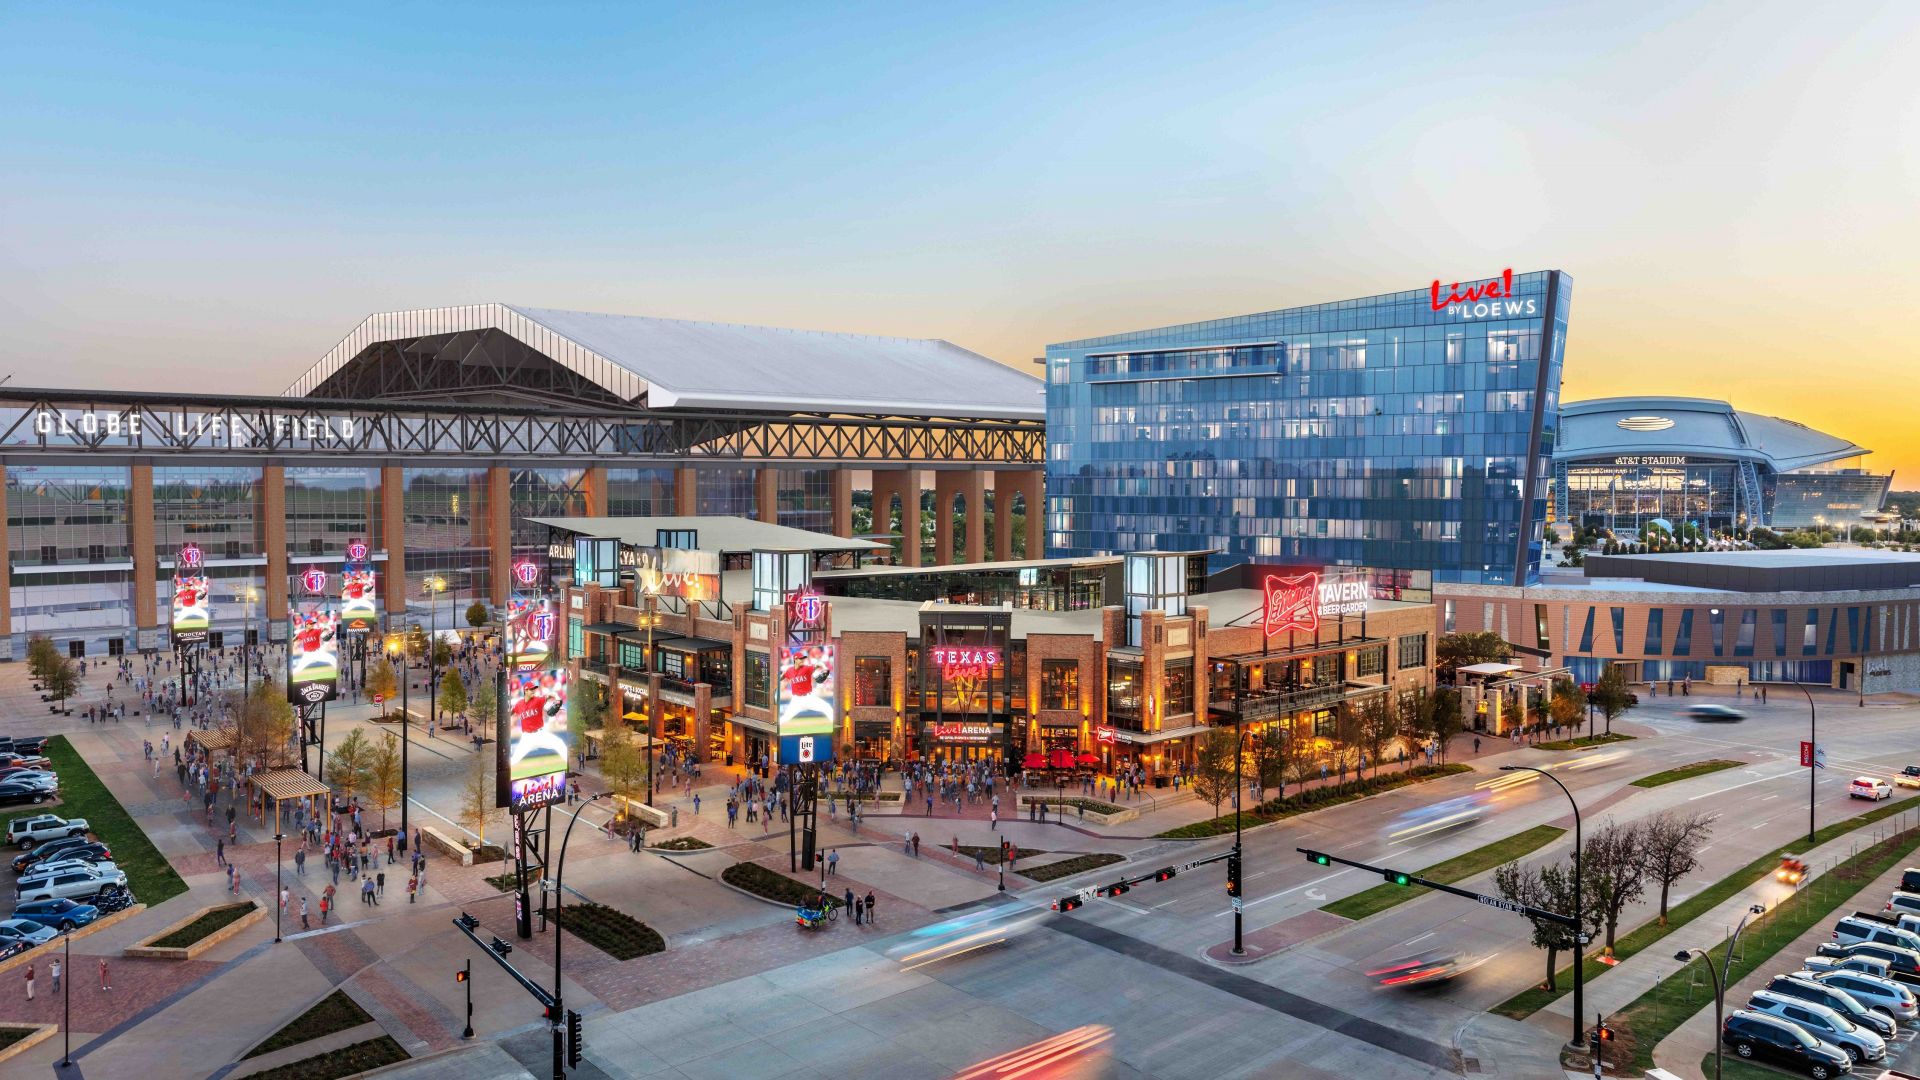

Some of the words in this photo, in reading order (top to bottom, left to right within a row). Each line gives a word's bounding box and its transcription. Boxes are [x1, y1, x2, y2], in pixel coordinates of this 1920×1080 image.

[1431, 269, 1512, 311] Live!
[1448, 305, 1461, 315] BY
[1463, 300, 1536, 319] LOEWS
[37, 411, 142, 435] GLOBE
[178, 414, 242, 437] LIFE
[274, 416, 354, 439] FIELD
[1615, 456, 1640, 465] AT&T
[1641, 456, 1686, 465] STADIUM
[549, 545, 575, 559] ARLIN
[1318, 581, 1368, 603] TAVERN
[1323, 604, 1341, 616] BEER
[1341, 601, 1368, 614] GARDEN
[935, 651, 996, 664] TEXAS
[945, 661, 986, 680] Live!
[935, 723, 961, 737] Live!
[962, 726, 991, 734] ARENA
[519, 789, 559, 806] ARENA
